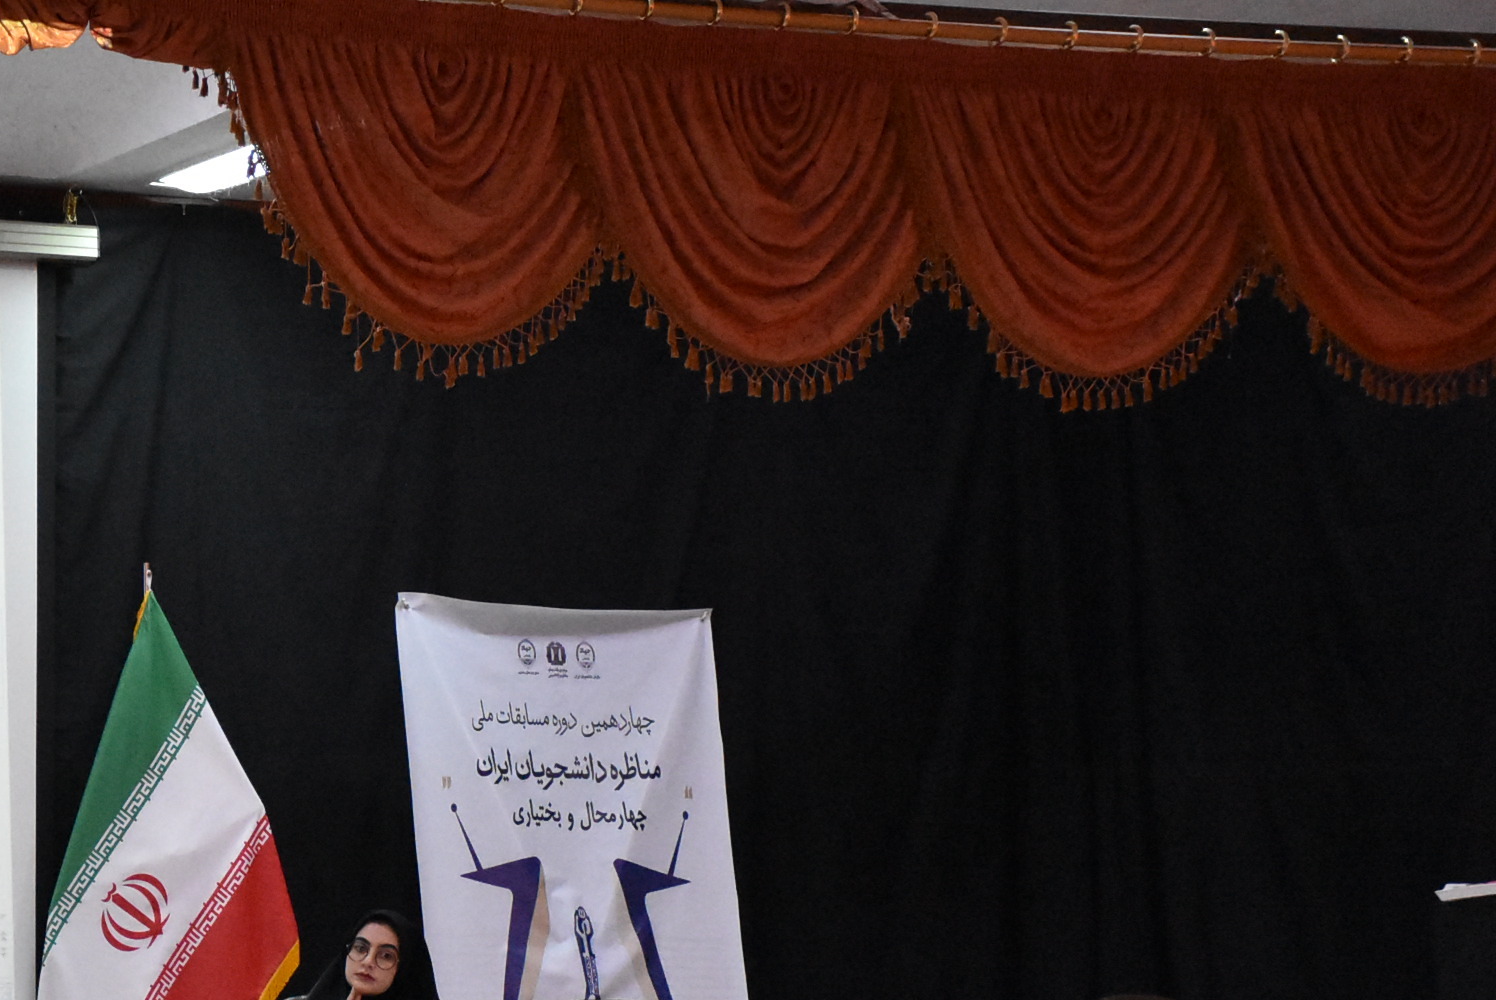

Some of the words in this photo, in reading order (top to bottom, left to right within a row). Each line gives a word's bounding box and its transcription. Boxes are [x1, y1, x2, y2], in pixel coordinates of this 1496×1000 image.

[471, 699, 494, 732] ملی
[495, 702, 550, 730] مسابقات
[551, 712, 578, 736] دوره
[580, 705, 656, 738] چهاردهمین
[476, 747, 513, 785] ایران
[514, 749, 608, 791] دانشجویان
[609, 751, 662, 791] مناظره
[512, 798, 562, 829] بختیاری
[567, 813, 575, 831] و
